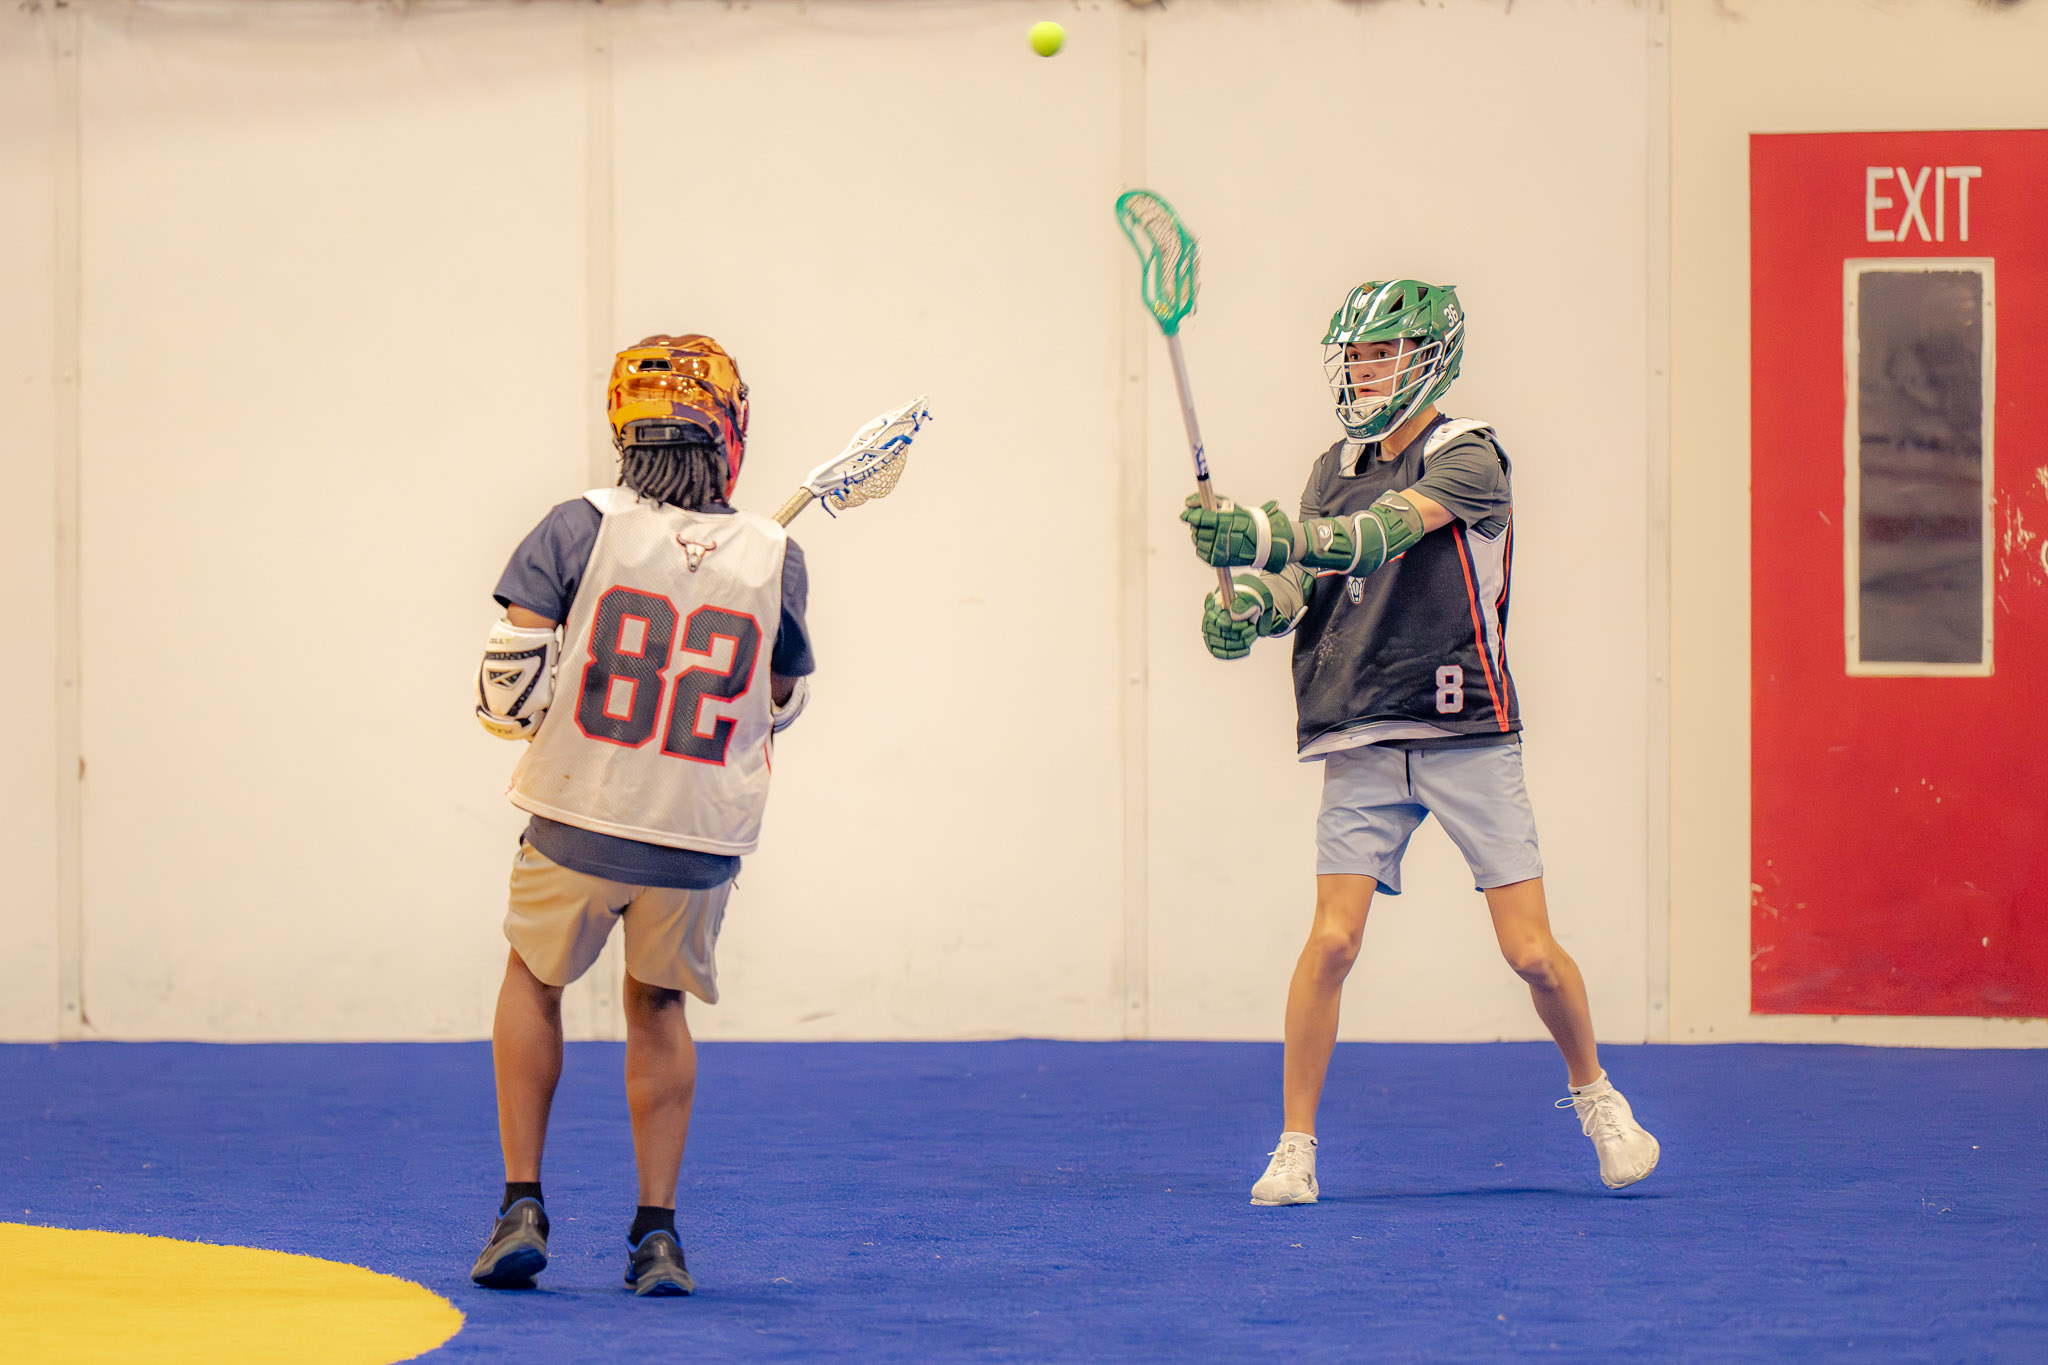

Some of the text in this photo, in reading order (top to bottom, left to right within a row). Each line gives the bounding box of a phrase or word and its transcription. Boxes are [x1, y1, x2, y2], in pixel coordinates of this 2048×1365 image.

[1865, 165, 1982, 242] EXIT
[1443, 303, 1459, 328] 36
[574, 584, 762, 767] 82
[1436, 664, 1464, 714] 8
